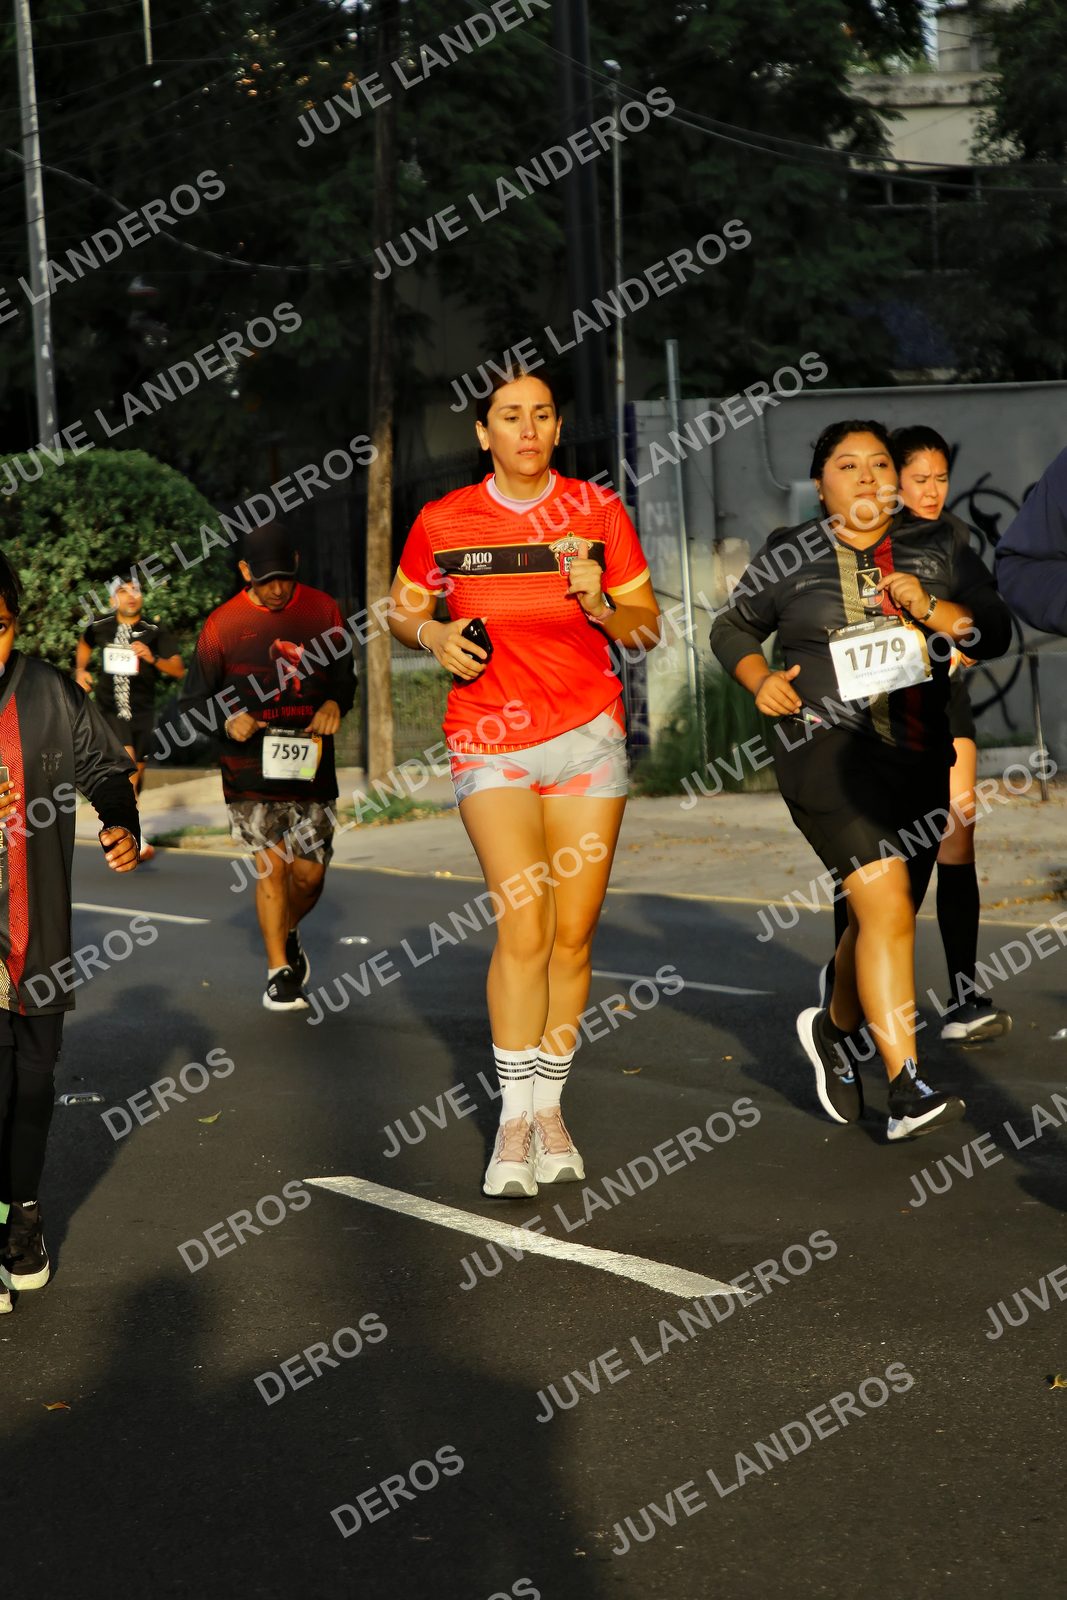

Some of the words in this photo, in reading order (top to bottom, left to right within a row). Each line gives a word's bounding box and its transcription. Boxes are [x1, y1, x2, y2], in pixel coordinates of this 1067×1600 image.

[471, 552, 492, 564] 100
[845, 637, 906, 670] 1779
[272, 743, 309, 760] 7597
